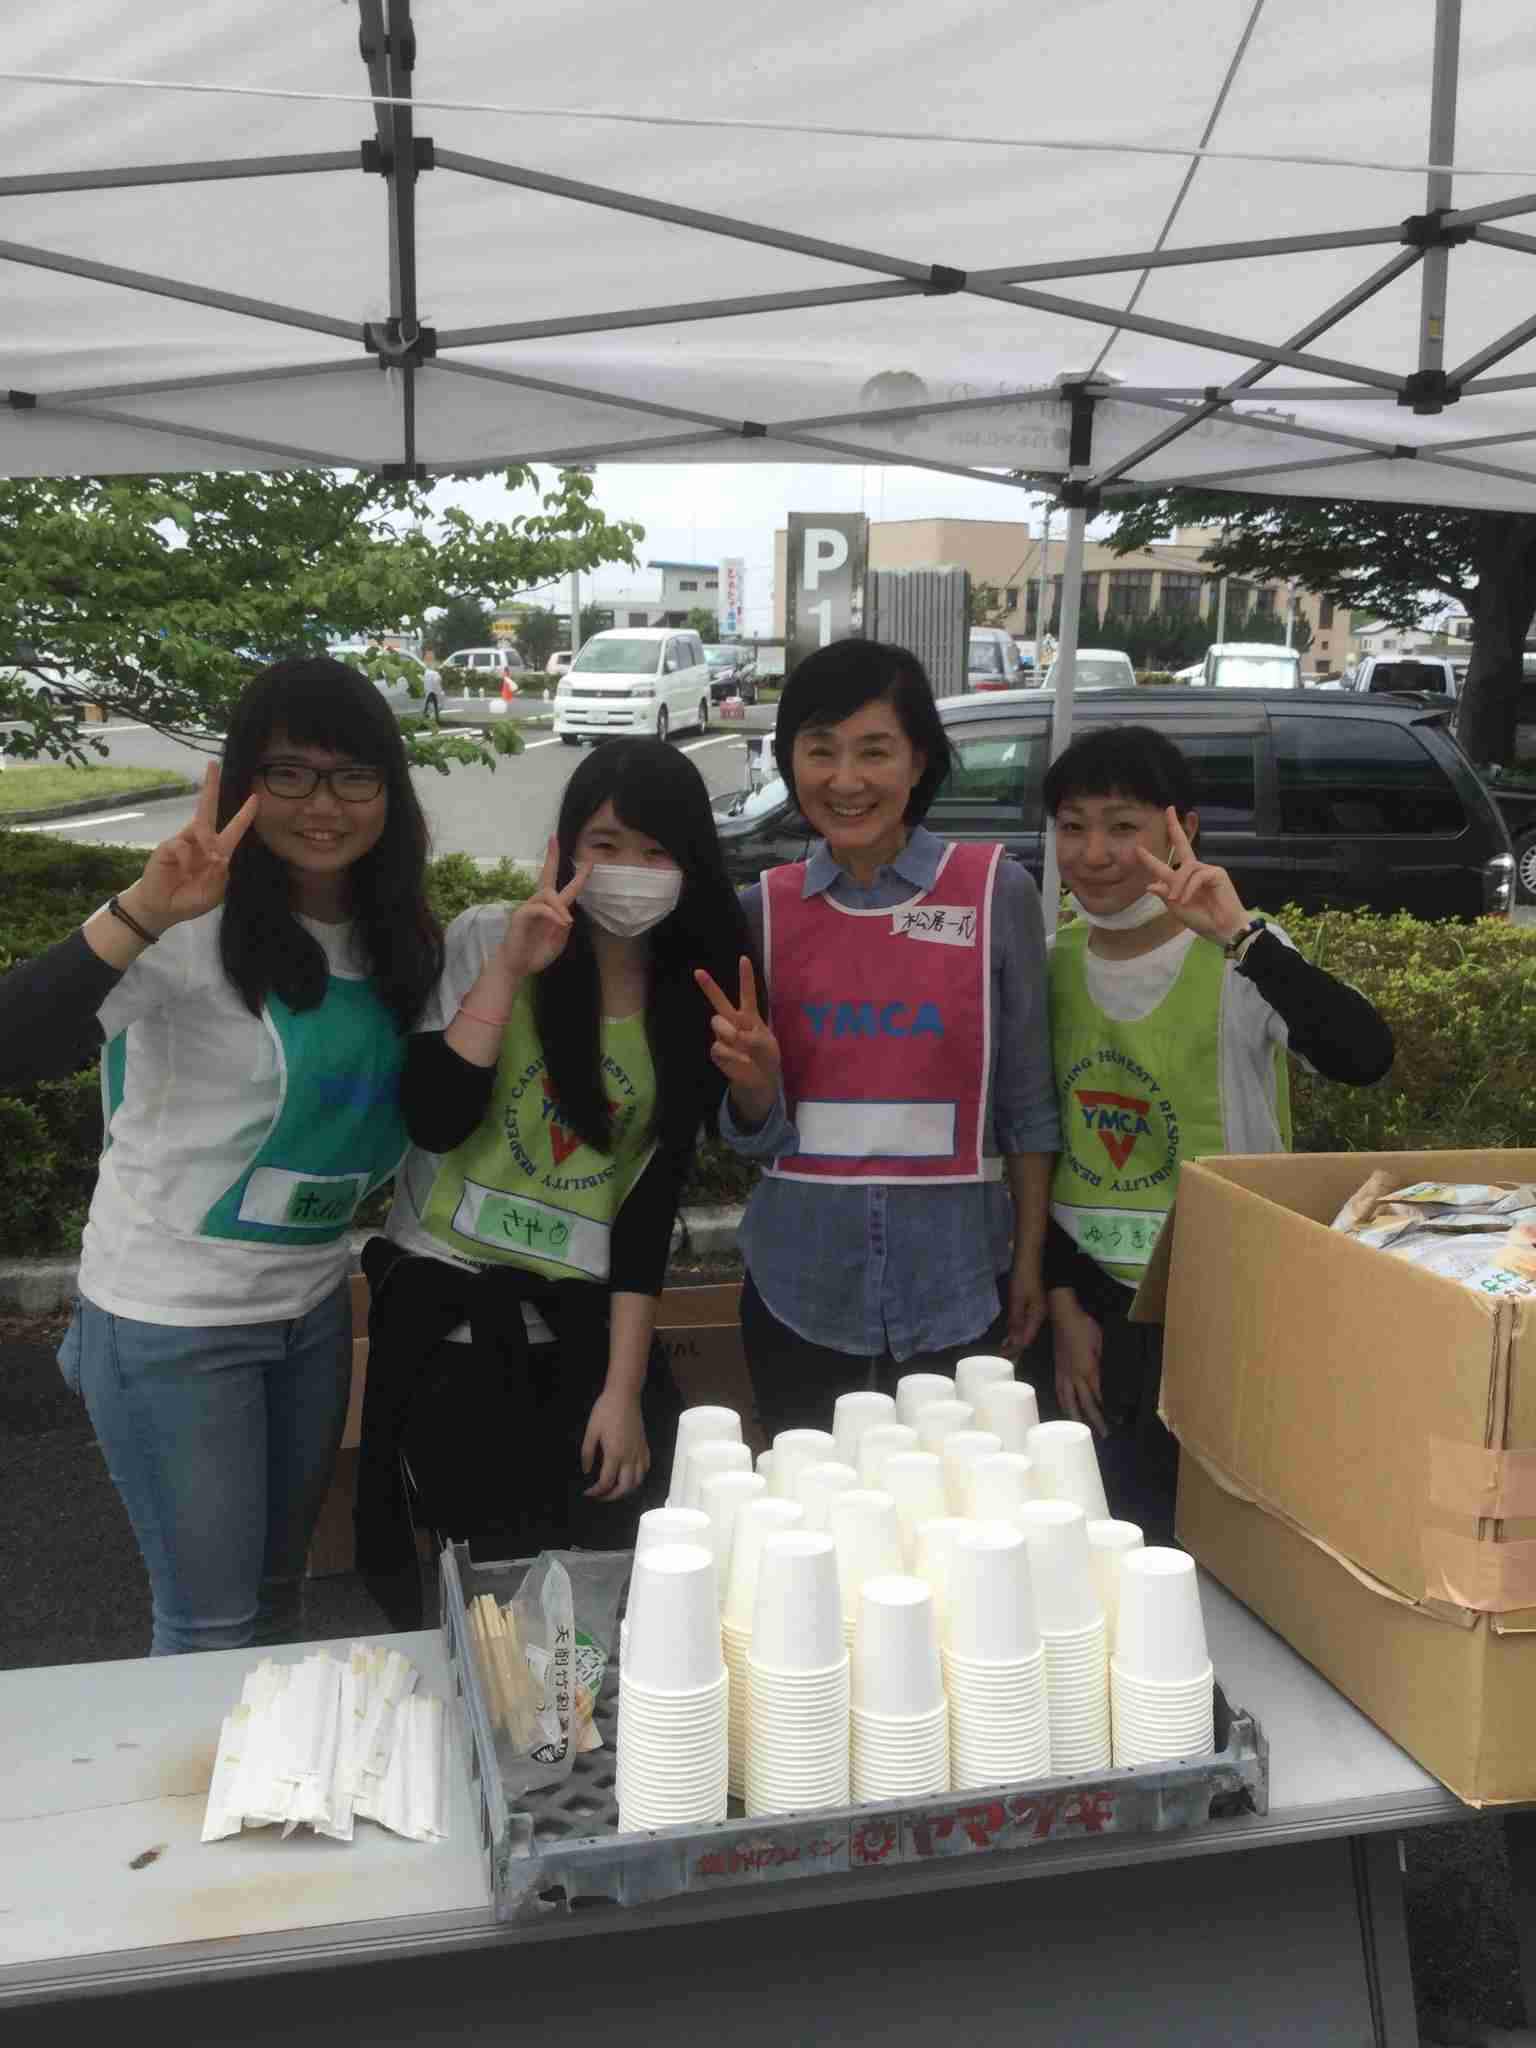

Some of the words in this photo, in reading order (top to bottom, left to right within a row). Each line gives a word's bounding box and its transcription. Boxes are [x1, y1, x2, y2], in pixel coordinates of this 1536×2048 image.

[803, 527, 849, 591] P
[807, 599, 832, 648] 1
[801, 1001, 947, 1041] YMCA
[503, 1104, 537, 1177] RESPECT
[1081, 1103, 1153, 1137] YMCA
